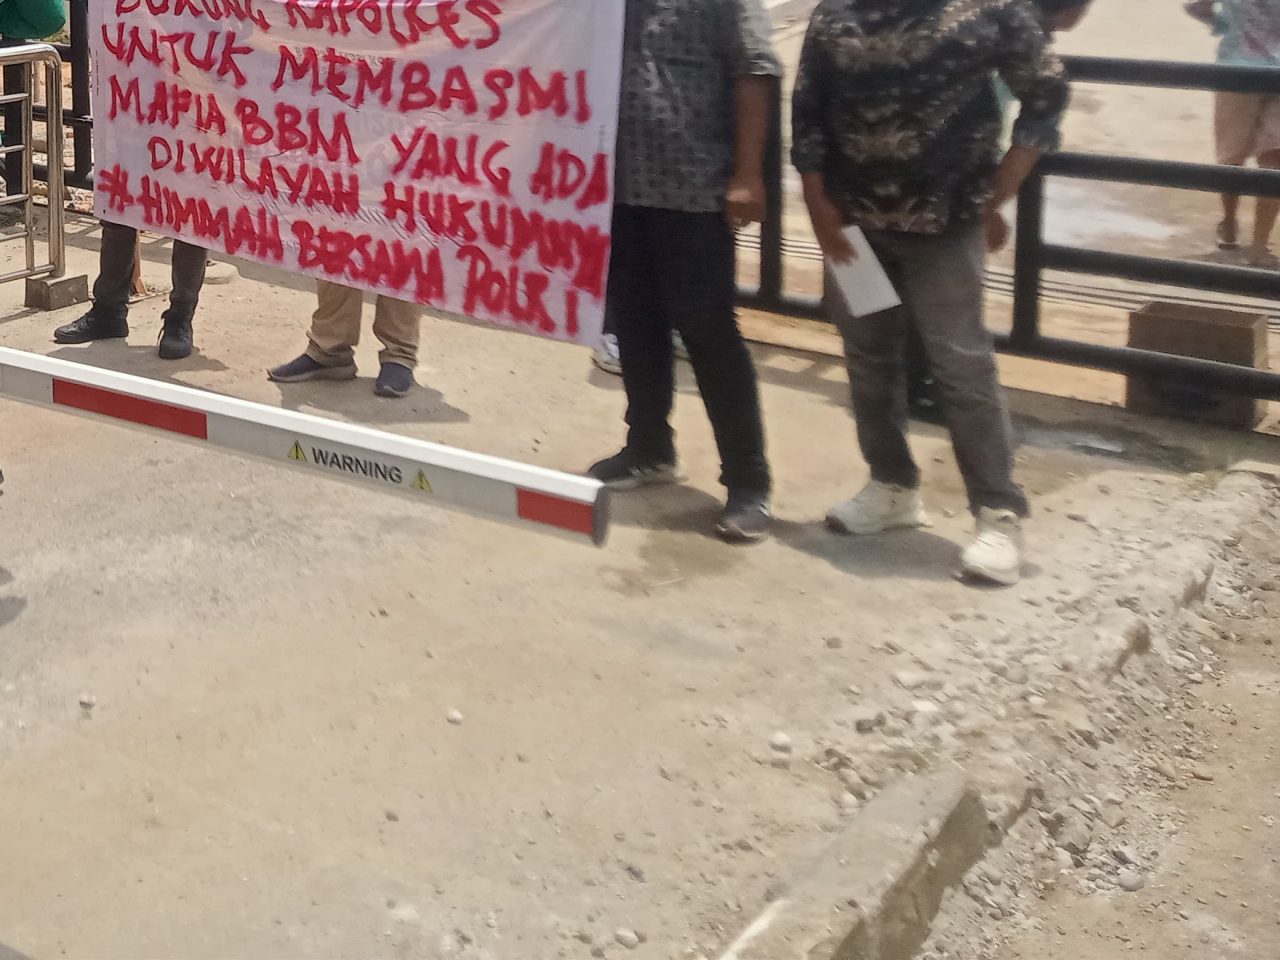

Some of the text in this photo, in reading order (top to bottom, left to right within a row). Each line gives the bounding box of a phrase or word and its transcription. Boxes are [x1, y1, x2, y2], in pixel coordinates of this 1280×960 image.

[101, 22, 590, 123] UNTUK MEMBASMI
[108, 74, 609, 211] MAFIA BBM YANG ADA
[311, 445, 404, 485] WARNING
